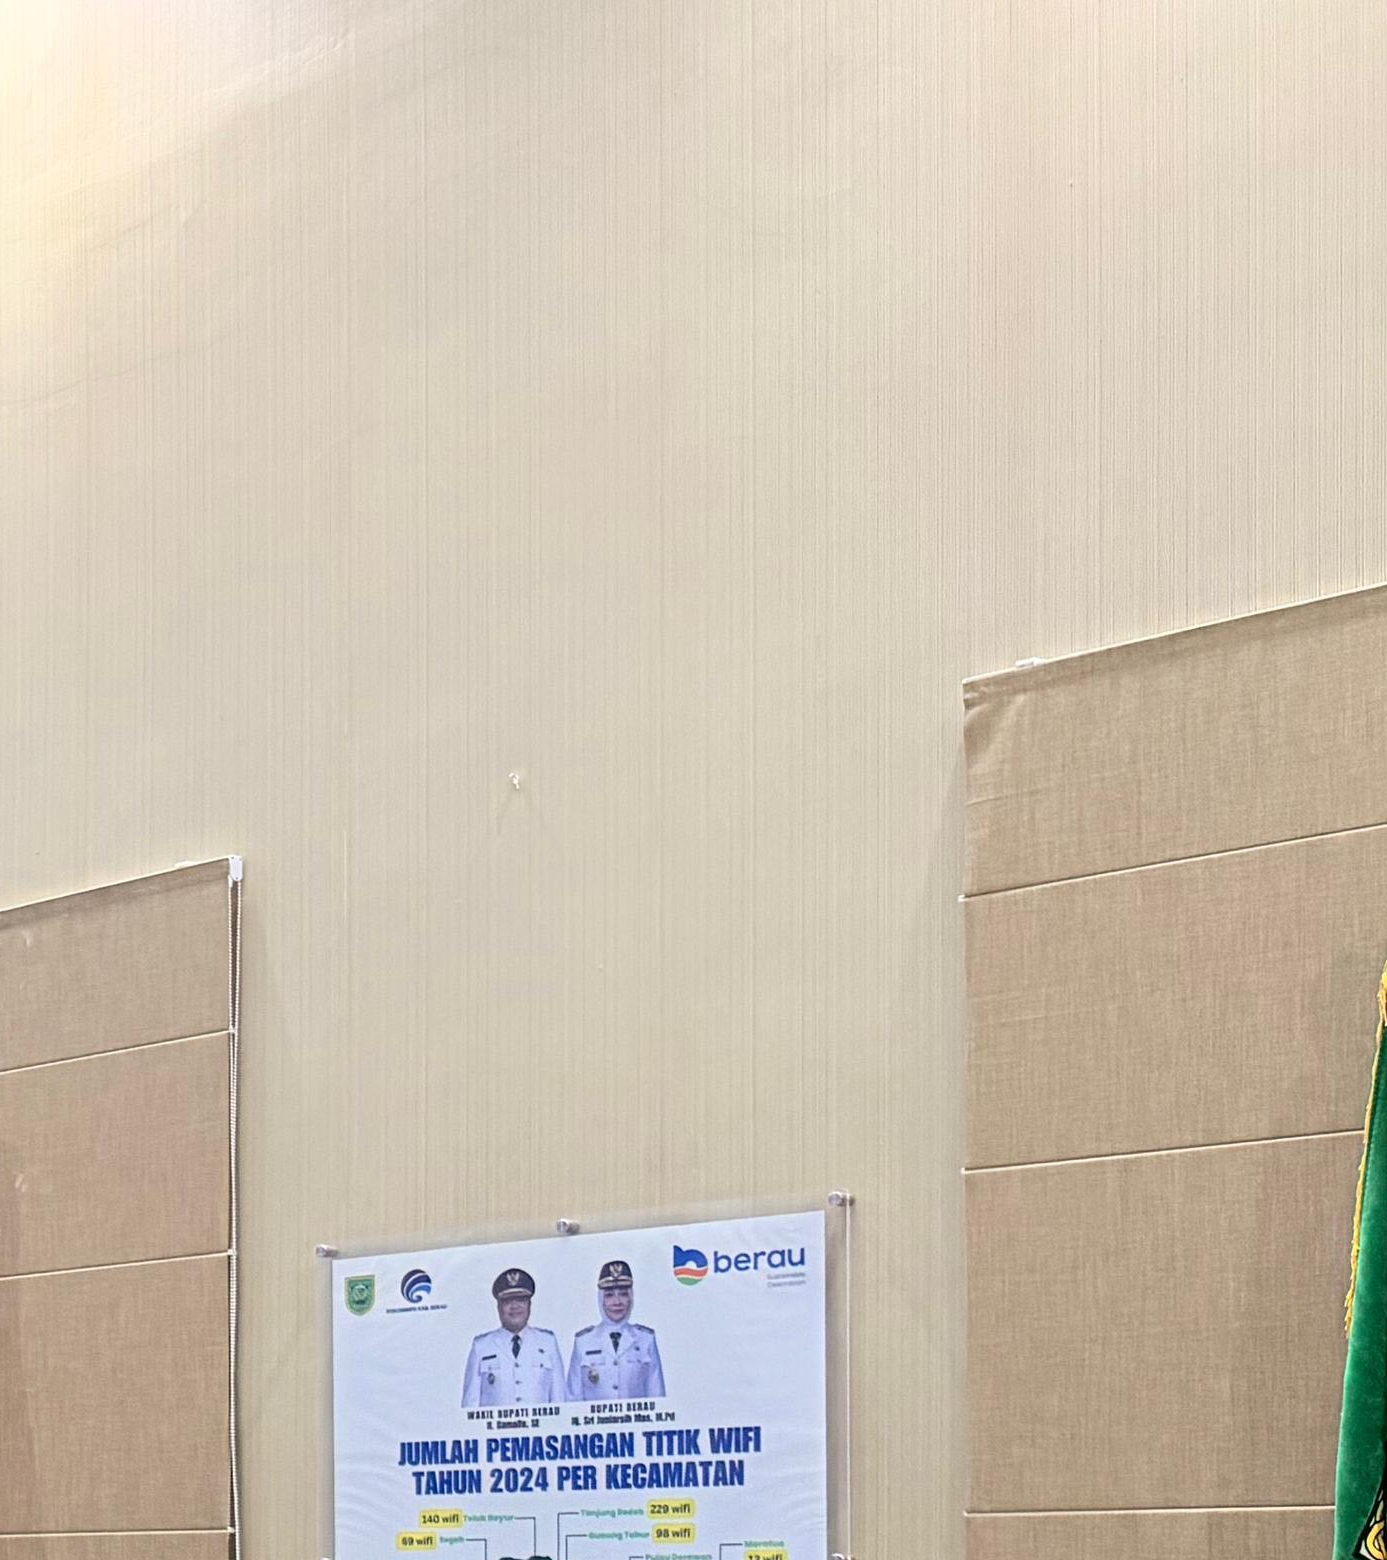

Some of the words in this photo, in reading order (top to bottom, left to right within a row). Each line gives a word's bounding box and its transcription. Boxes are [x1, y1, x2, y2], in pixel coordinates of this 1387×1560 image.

[713, 1247, 805, 1273] berau
[497, 1408, 529, 1419] BUPATI
[532, 1406, 560, 1417] BERAU
[590, 1403, 623, 1414] BUPATI
[626, 1401, 656, 1412] BERAU
[398, 1438, 478, 1466] JUMLAH
[486, 1432, 634, 1463] PEMASANGAN
[642, 1429, 701, 1456] TITIK
[708, 1426, 762, 1454] WIFI
[412, 1468, 482, 1495] TAHUN
[490, 1466, 549, 1493] 2024
[557, 1465, 597, 1491] PER
[605, 1459, 745, 1490] KECAMATAN
[671, 1503, 691, 1514] wifi
[422, 1514, 440, 1524] 140
[441, 1513, 460, 1524] wifi
[415, 1535, 434, 1545] wifi
[656, 1528, 670, 1539] 98
[671, 1528, 691, 1538] wifi
